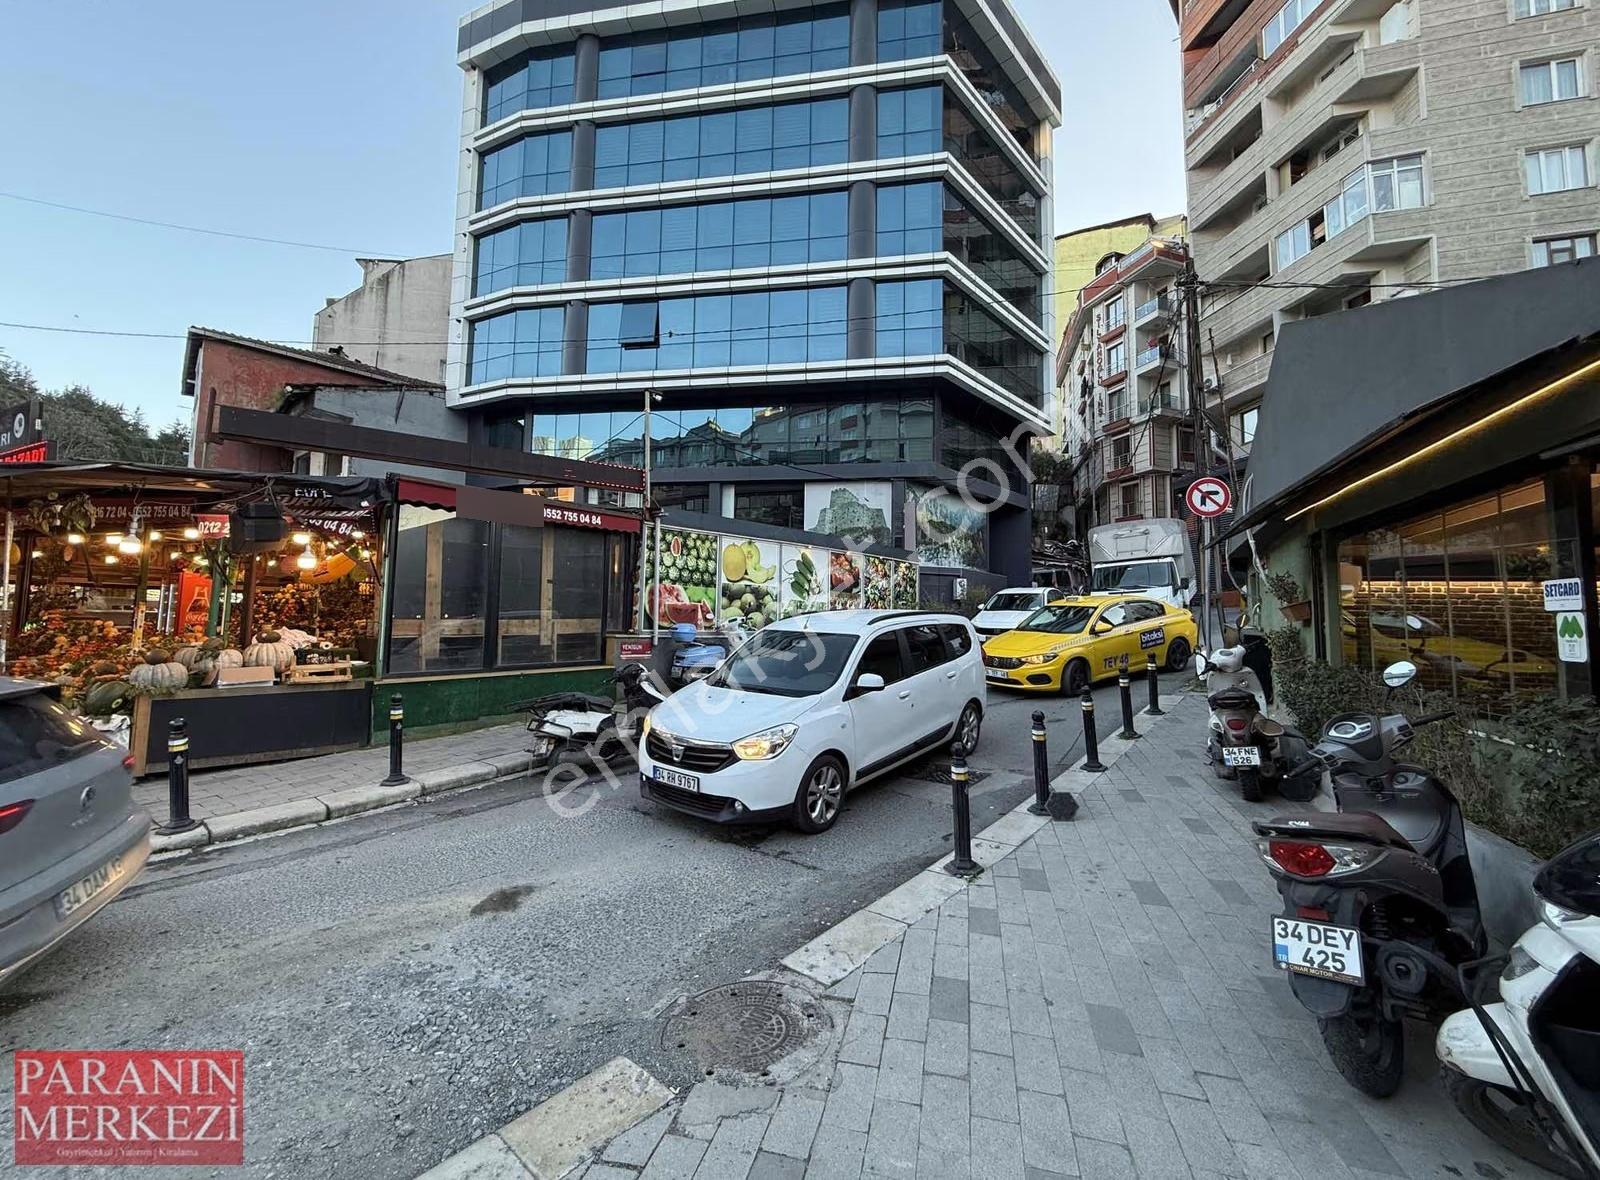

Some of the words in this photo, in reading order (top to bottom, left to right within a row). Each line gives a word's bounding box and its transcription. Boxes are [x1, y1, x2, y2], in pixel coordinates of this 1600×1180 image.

[563, 510, 579, 522] 755
[579, 513, 591, 524] 04
[591, 515, 602, 526] 84
[198, 521, 222, 534] 0212
[338, 522, 353, 536] 84
[1544, 581, 1580, 598] SETCARD
[1141, 629, 1163, 643] bitaksi
[1224, 748, 1236, 756] 34
[1237, 747, 1257, 756] FNE
[1232, 756, 1252, 765] 526
[655, 768, 665, 781] 34
[677, 774, 697, 790] 9767
[63, 886, 81, 911] 34
[1276, 920, 1303, 942] 34
[1306, 924, 1355, 951] DEY
[1302, 947, 1346, 973] 425
